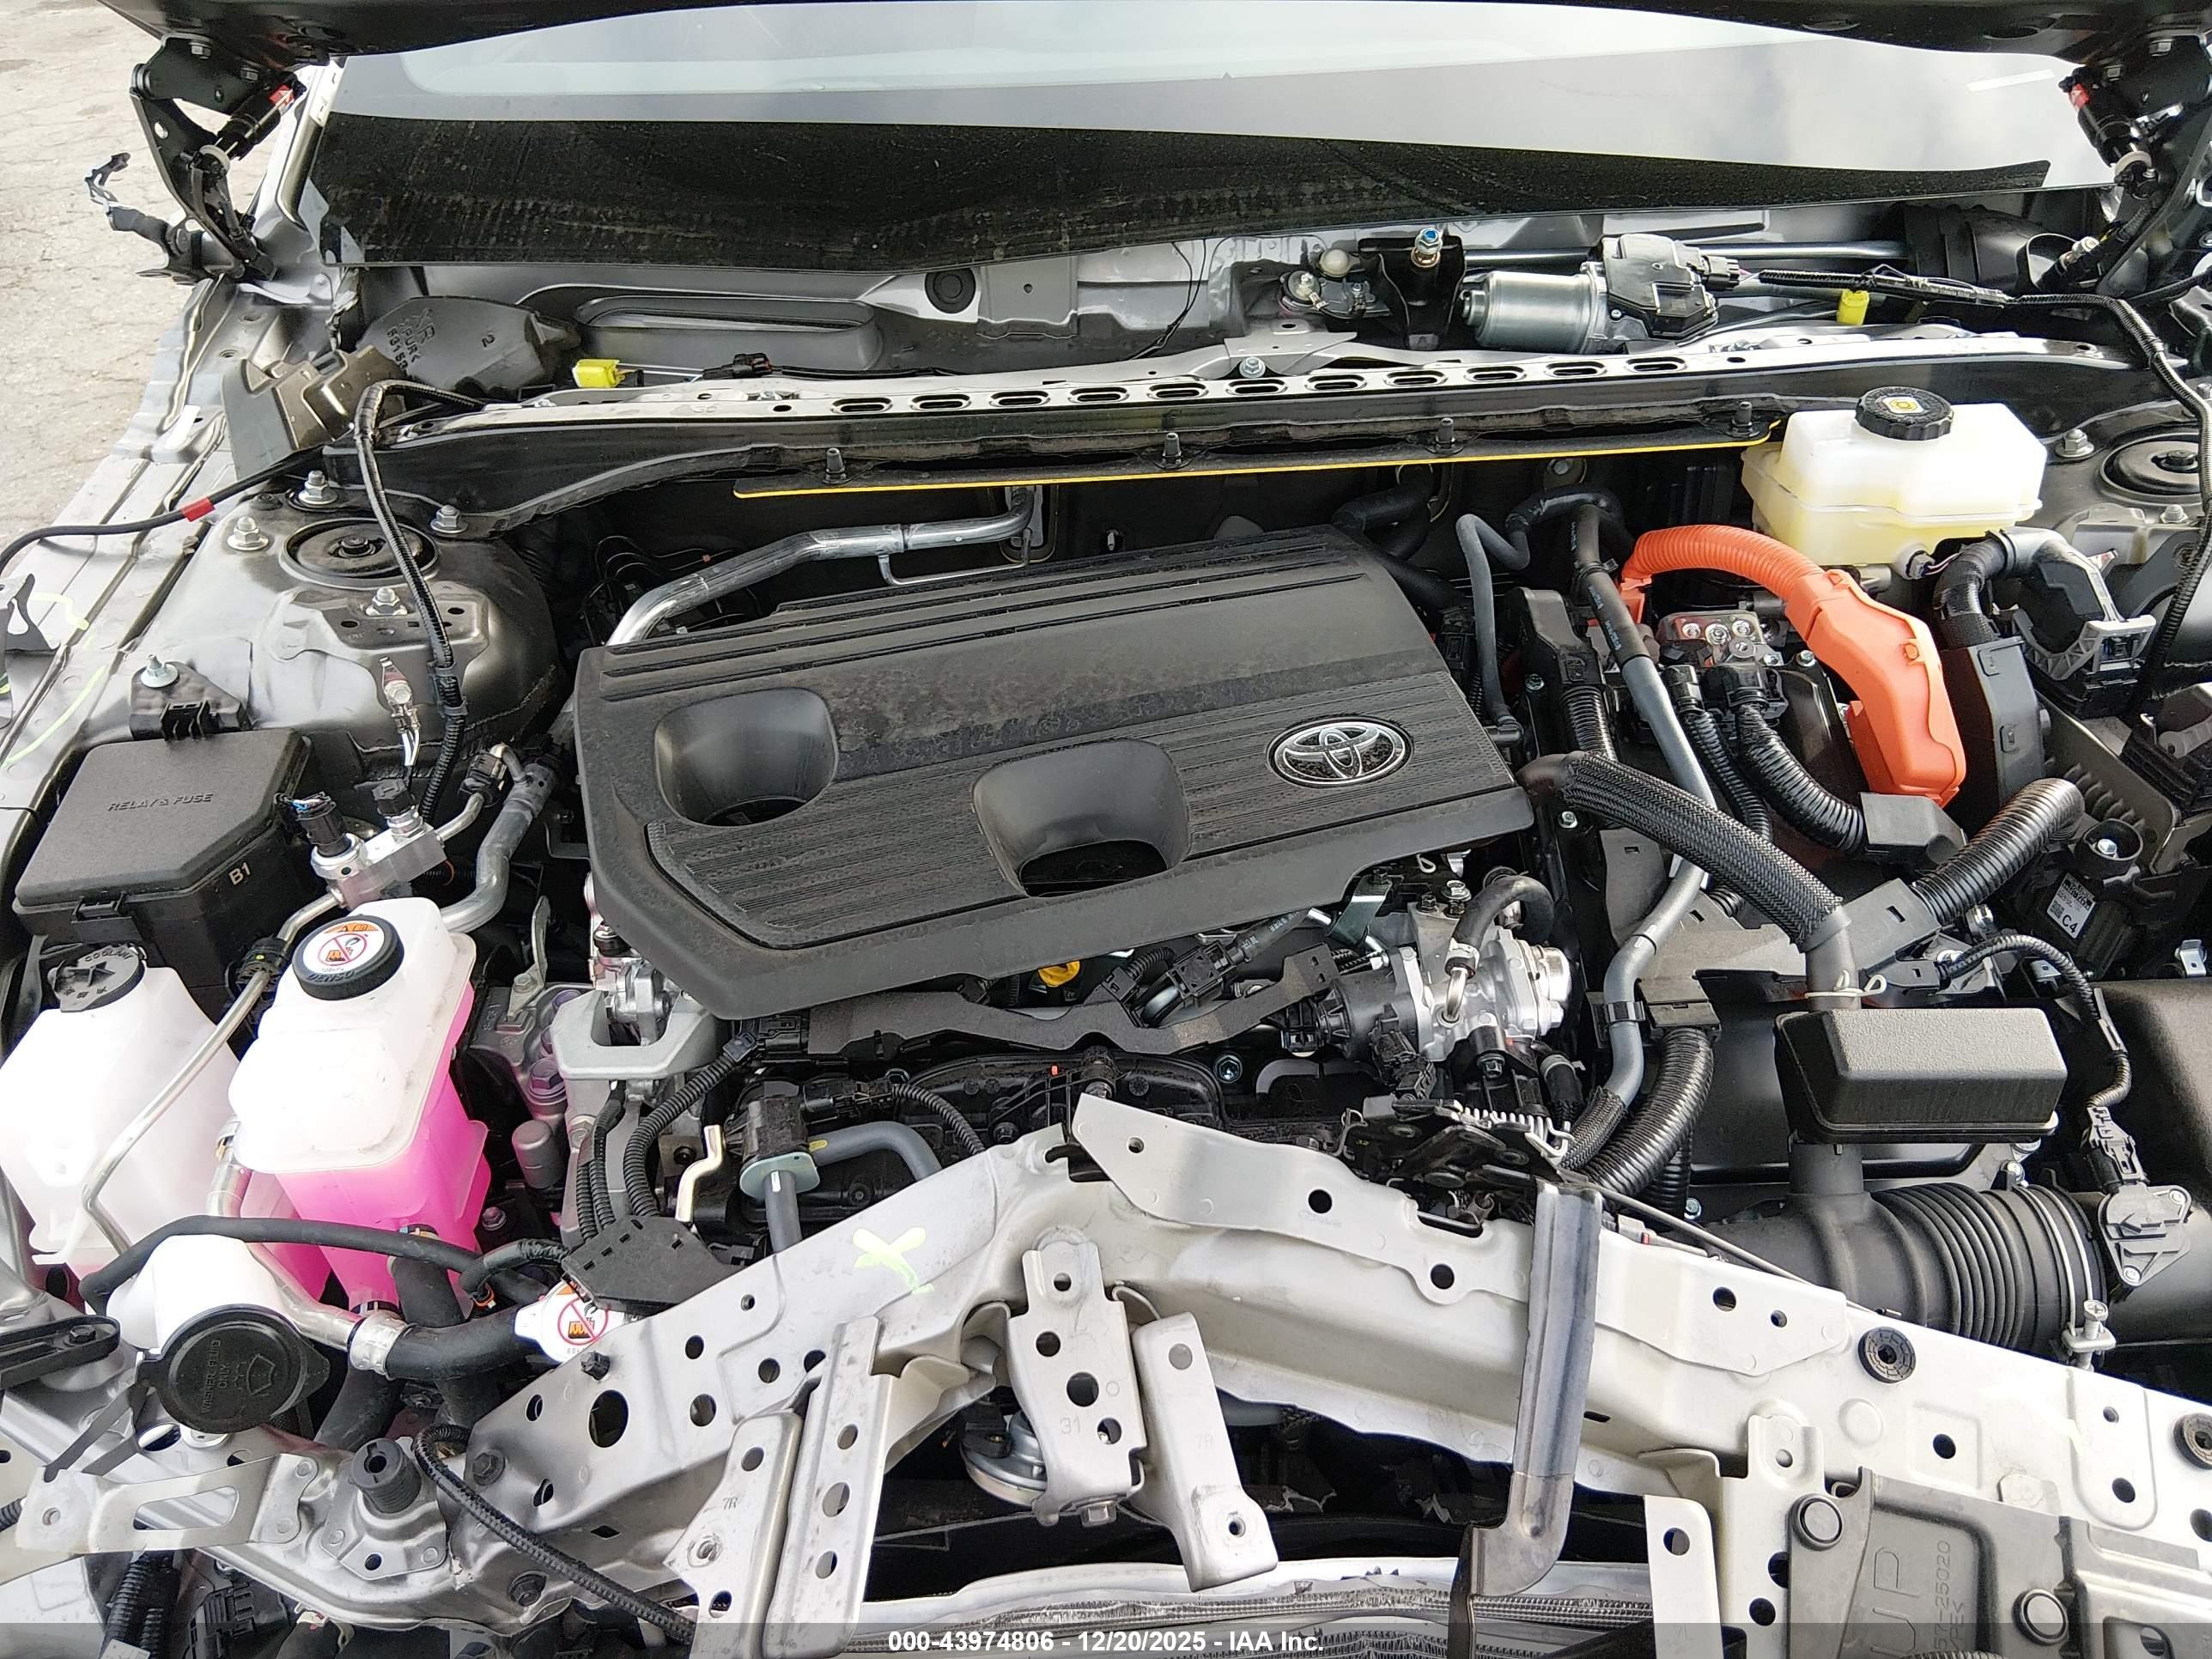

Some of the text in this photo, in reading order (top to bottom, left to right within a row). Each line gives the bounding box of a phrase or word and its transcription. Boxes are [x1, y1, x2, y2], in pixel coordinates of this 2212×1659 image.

[108, 798, 159, 811] RELAY
[173, 793, 214, 805] FUSE
[228, 861, 252, 886] B1
[2062, 914, 2078, 933] C4
[84, 948, 134, 963] COOLANT
[308, 969, 356, 983] DENSO
[1060, 1416, 1081, 1435] 31
